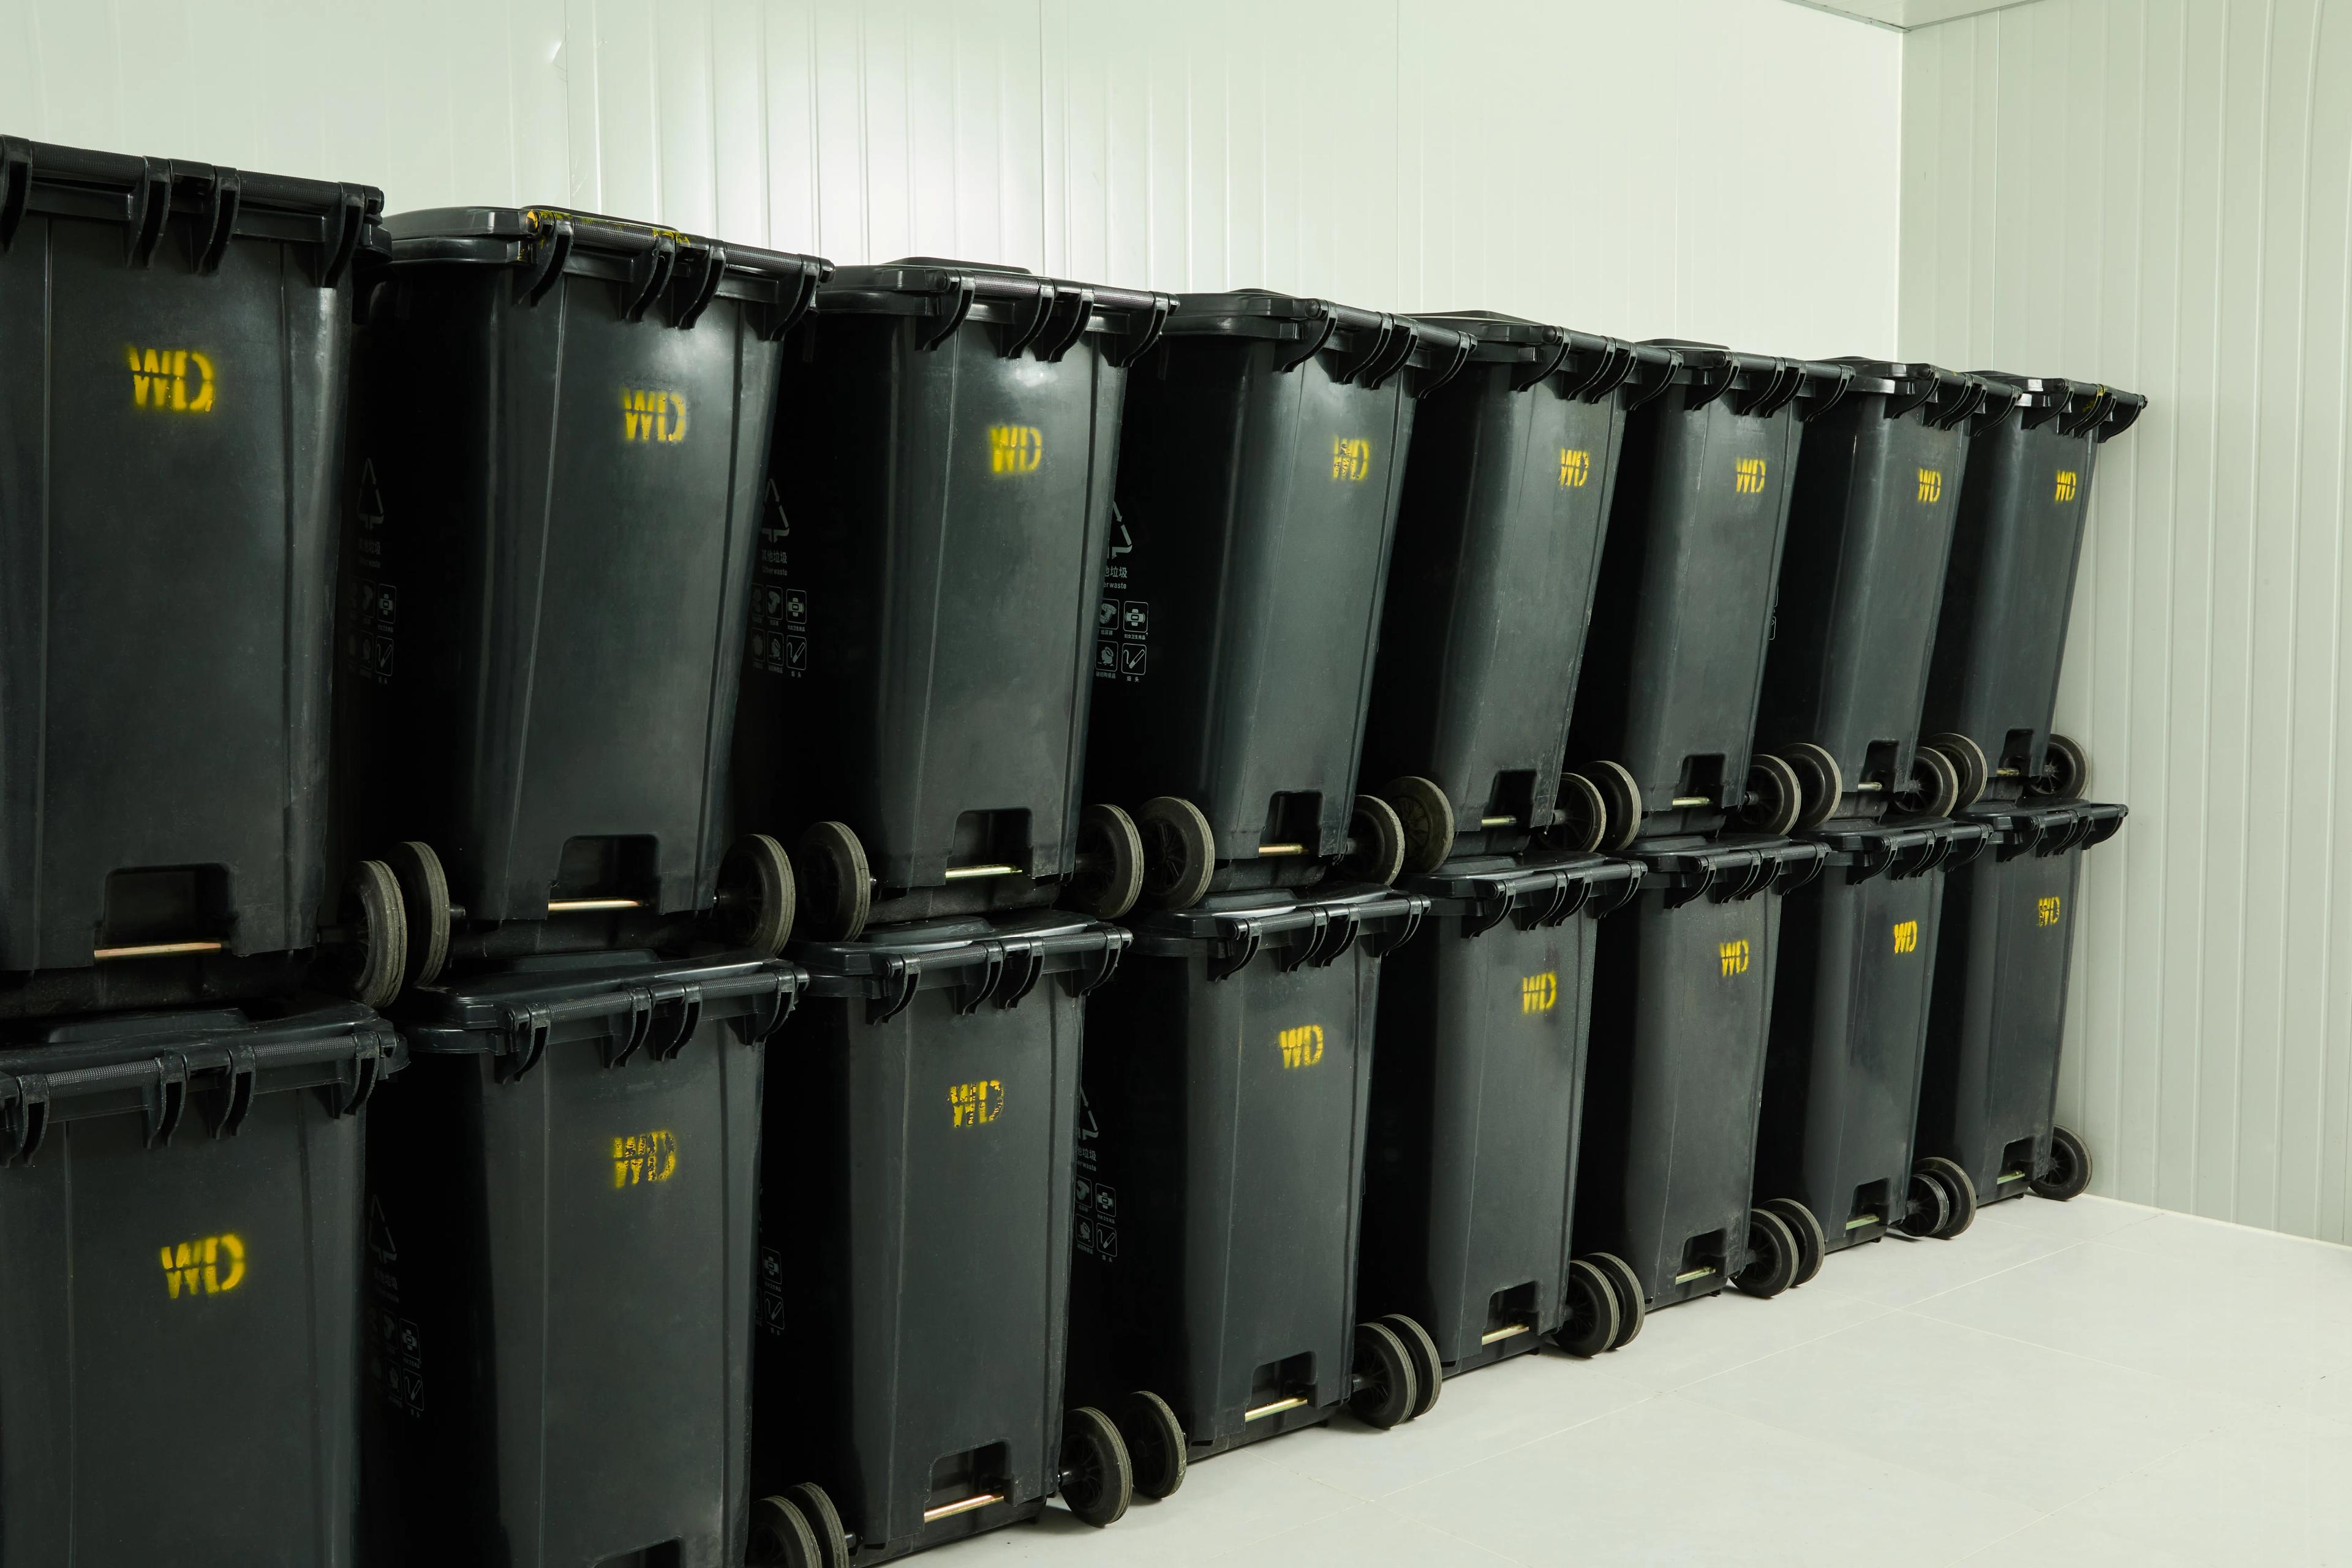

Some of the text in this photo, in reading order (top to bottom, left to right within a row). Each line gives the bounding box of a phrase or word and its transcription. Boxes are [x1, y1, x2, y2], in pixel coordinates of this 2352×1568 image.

[129, 349, 216, 413] WD
[620, 388, 684, 441] WD
[988, 425, 1040, 475] WD
[1559, 450, 1589, 487] WD
[1736, 459, 1765, 492] WD
[1917, 468, 1940, 502] WD
[2055, 470, 2077, 502] WD
[1719, 939, 1749, 976] WD
[1893, 920, 1918, 955] WD
[1522, 971, 1558, 1012] WD
[1279, 1025, 1323, 1068] WD
[949, 1079, 1003, 1127] WD
[612, 1129, 677, 1188] WD
[160, 1234, 245, 1298] WD
